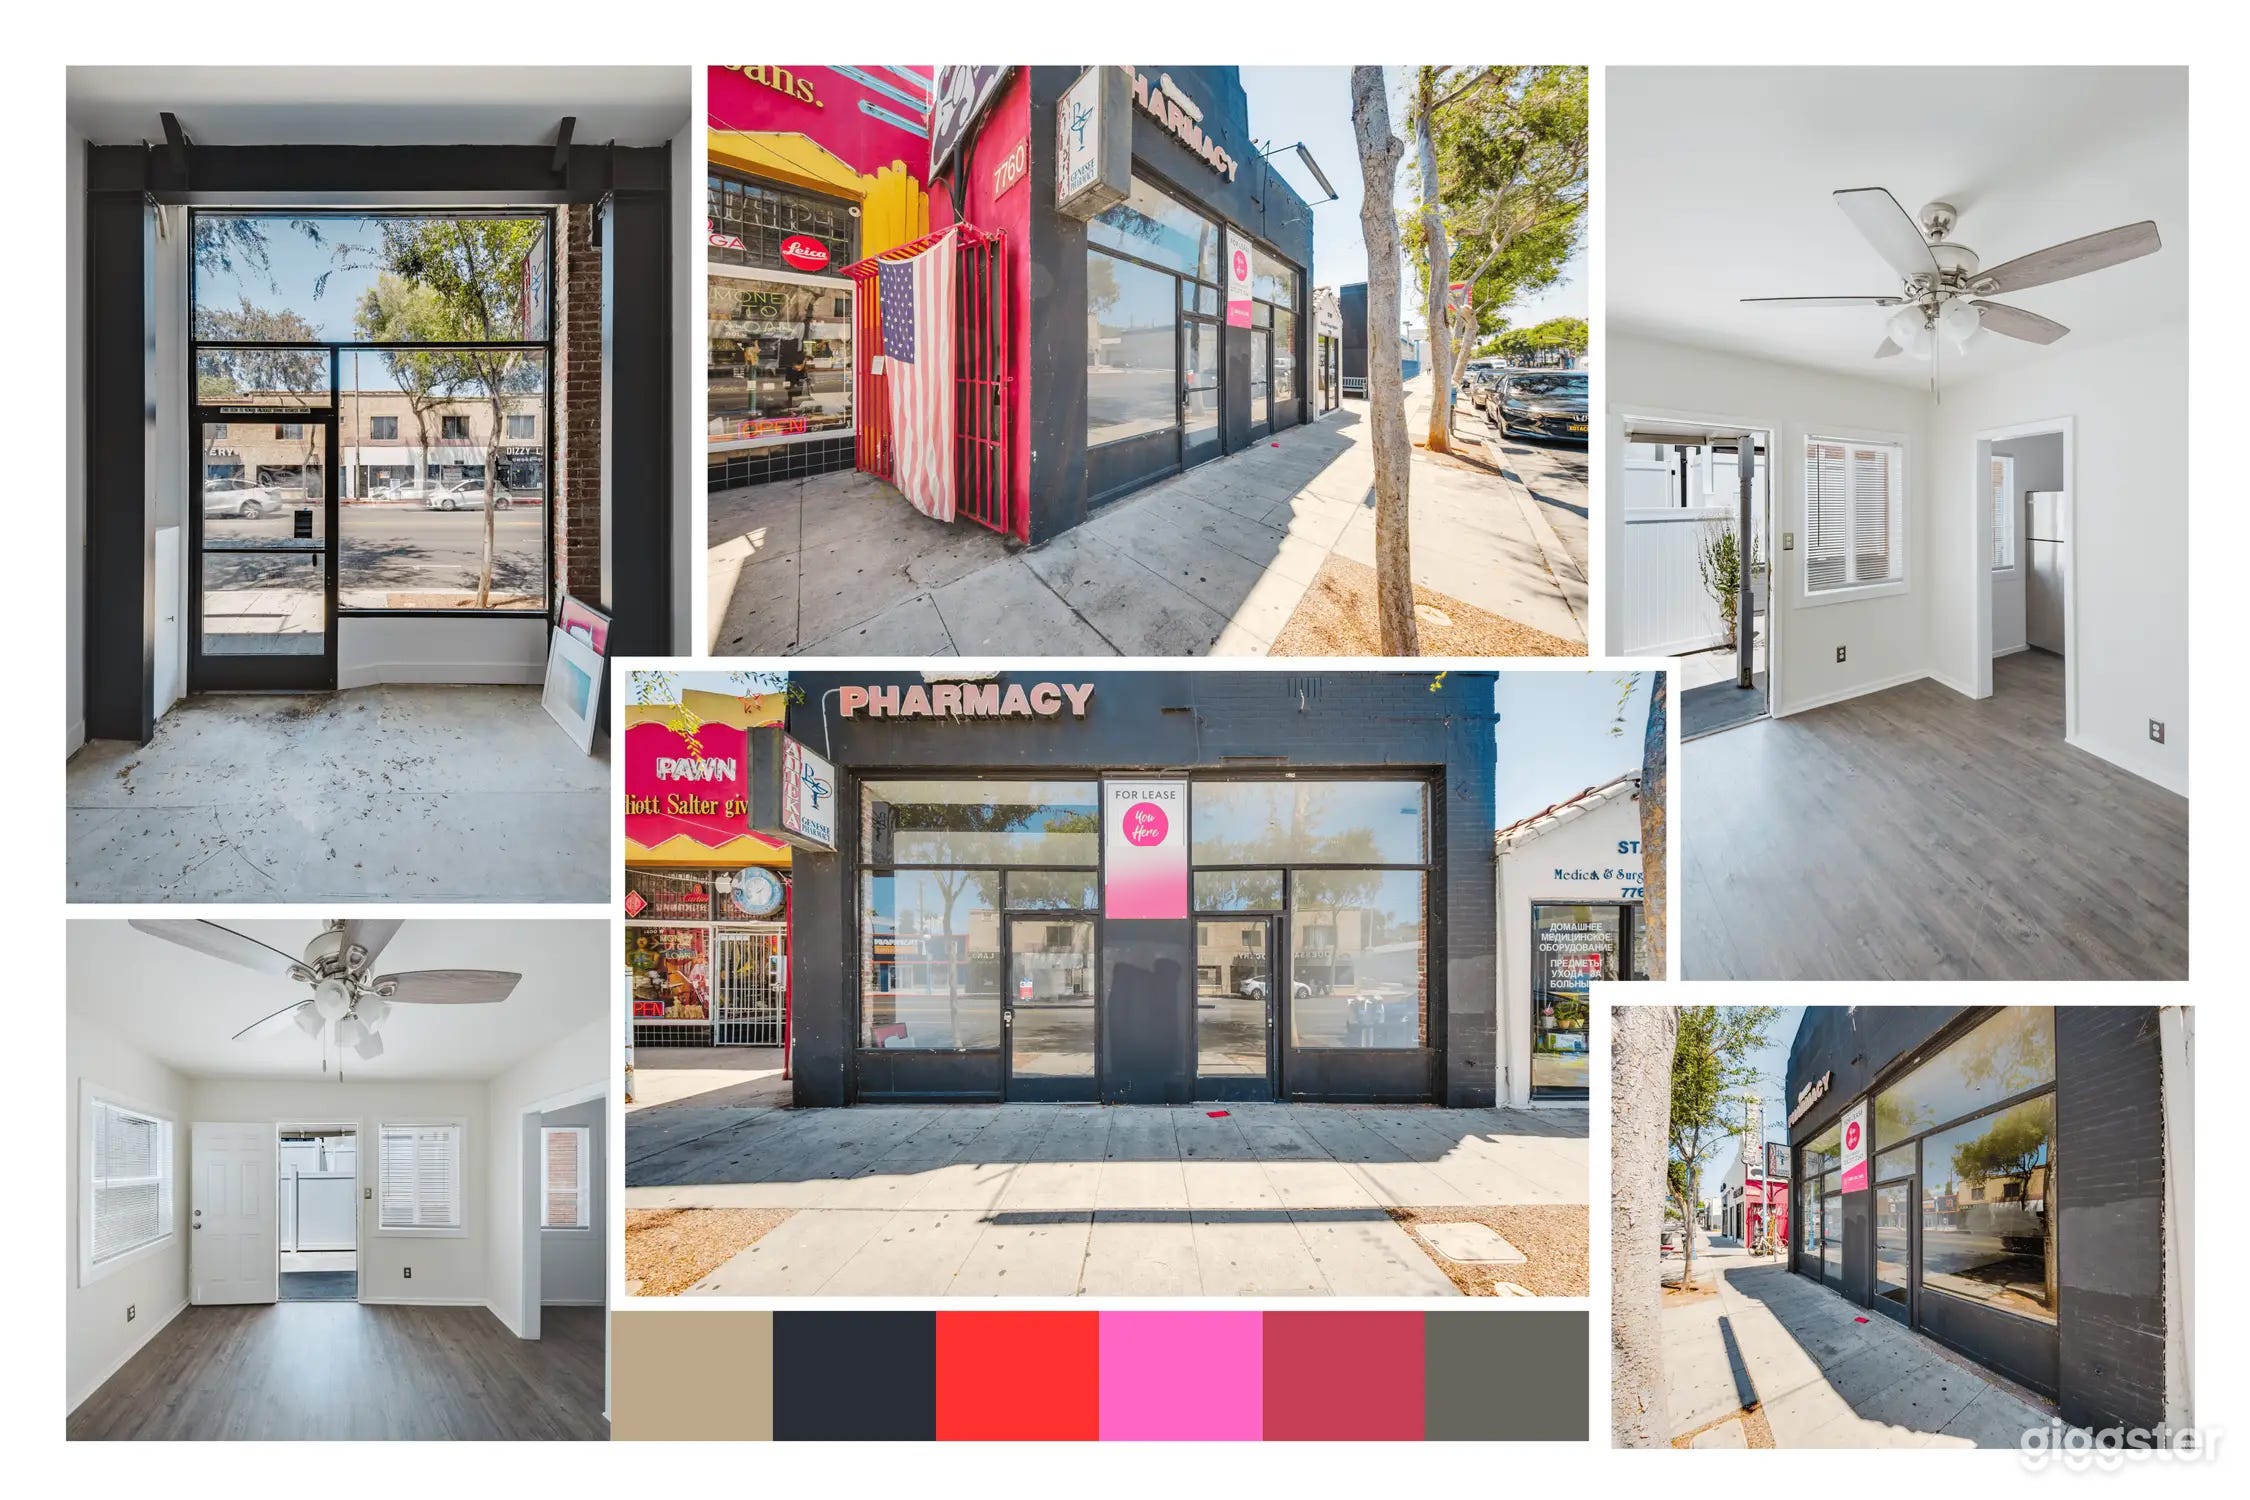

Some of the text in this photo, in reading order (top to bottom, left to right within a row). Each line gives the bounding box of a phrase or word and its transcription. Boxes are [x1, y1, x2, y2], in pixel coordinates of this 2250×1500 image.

[1120, 65, 1238, 182] HARMACY
[994, 144, 1025, 195] 7760
[783, 242, 828, 261] Leica
[714, 288, 797, 305] MONEY
[742, 418, 803, 438] OPEN
[205, 448, 234, 456] ERY
[506, 447, 531, 455] DIZZY
[839, 682, 1095, 717] PHARMACY
[656, 757, 737, 782] PAWN
[1115, 790, 1176, 800] FOR LEASE
[667, 793, 719, 815] Salter
[1135, 810, 1155, 824] You
[1132, 825, 1160, 842] Here
[1618, 841, 1642, 854] ST
[1603, 868, 1614, 880] &
[1550, 923, 1602, 932] ДОМАШНЕЕ
[1541, 933, 1612, 942] МЕДИЦИНСКОЕ
[1540, 943, 1613, 952] ОБОРУДОВАНИЕ
[1550, 959, 1602, 969] ПРЕДМЕТЫ
[1552, 969, 1584, 979] УХОДА
[633, 1002, 664, 1017] PEN
